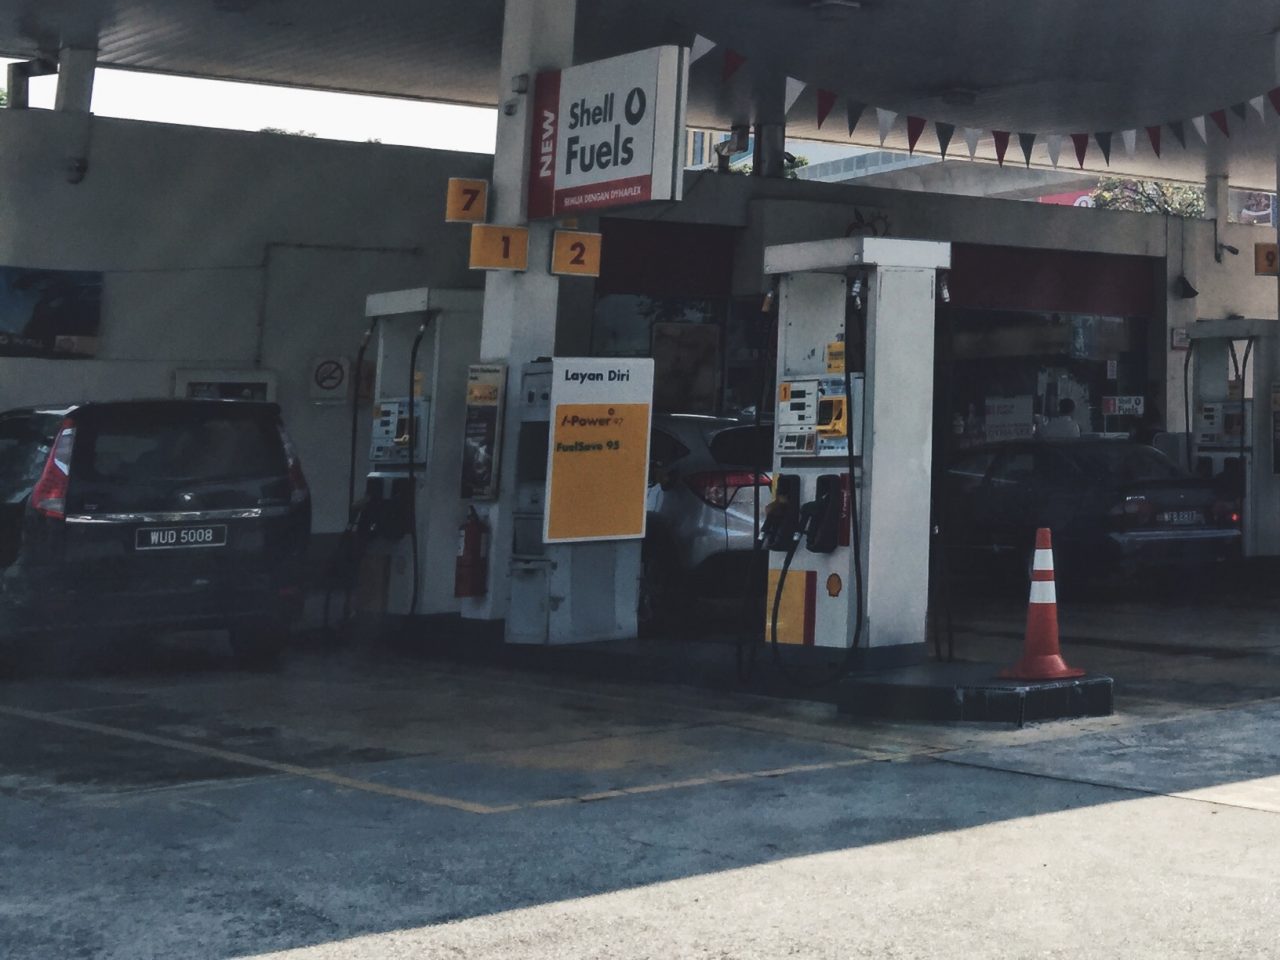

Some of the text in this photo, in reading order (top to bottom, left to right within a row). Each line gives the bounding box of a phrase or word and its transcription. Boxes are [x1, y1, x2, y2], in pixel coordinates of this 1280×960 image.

[567, 92, 614, 130] Shell
[539, 110, 555, 178] NEW
[565, 123, 634, 175] Fuels
[462, 189, 480, 211] 7
[502, 236, 510, 259] 1
[570, 242, 586, 265] 2
[1266, 251, 1276, 267] 9
[565, 369, 630, 384] Layan Diri
[556, 440, 620, 452] FuelSave 95
[151, 528, 213, 544] WUD 5008
